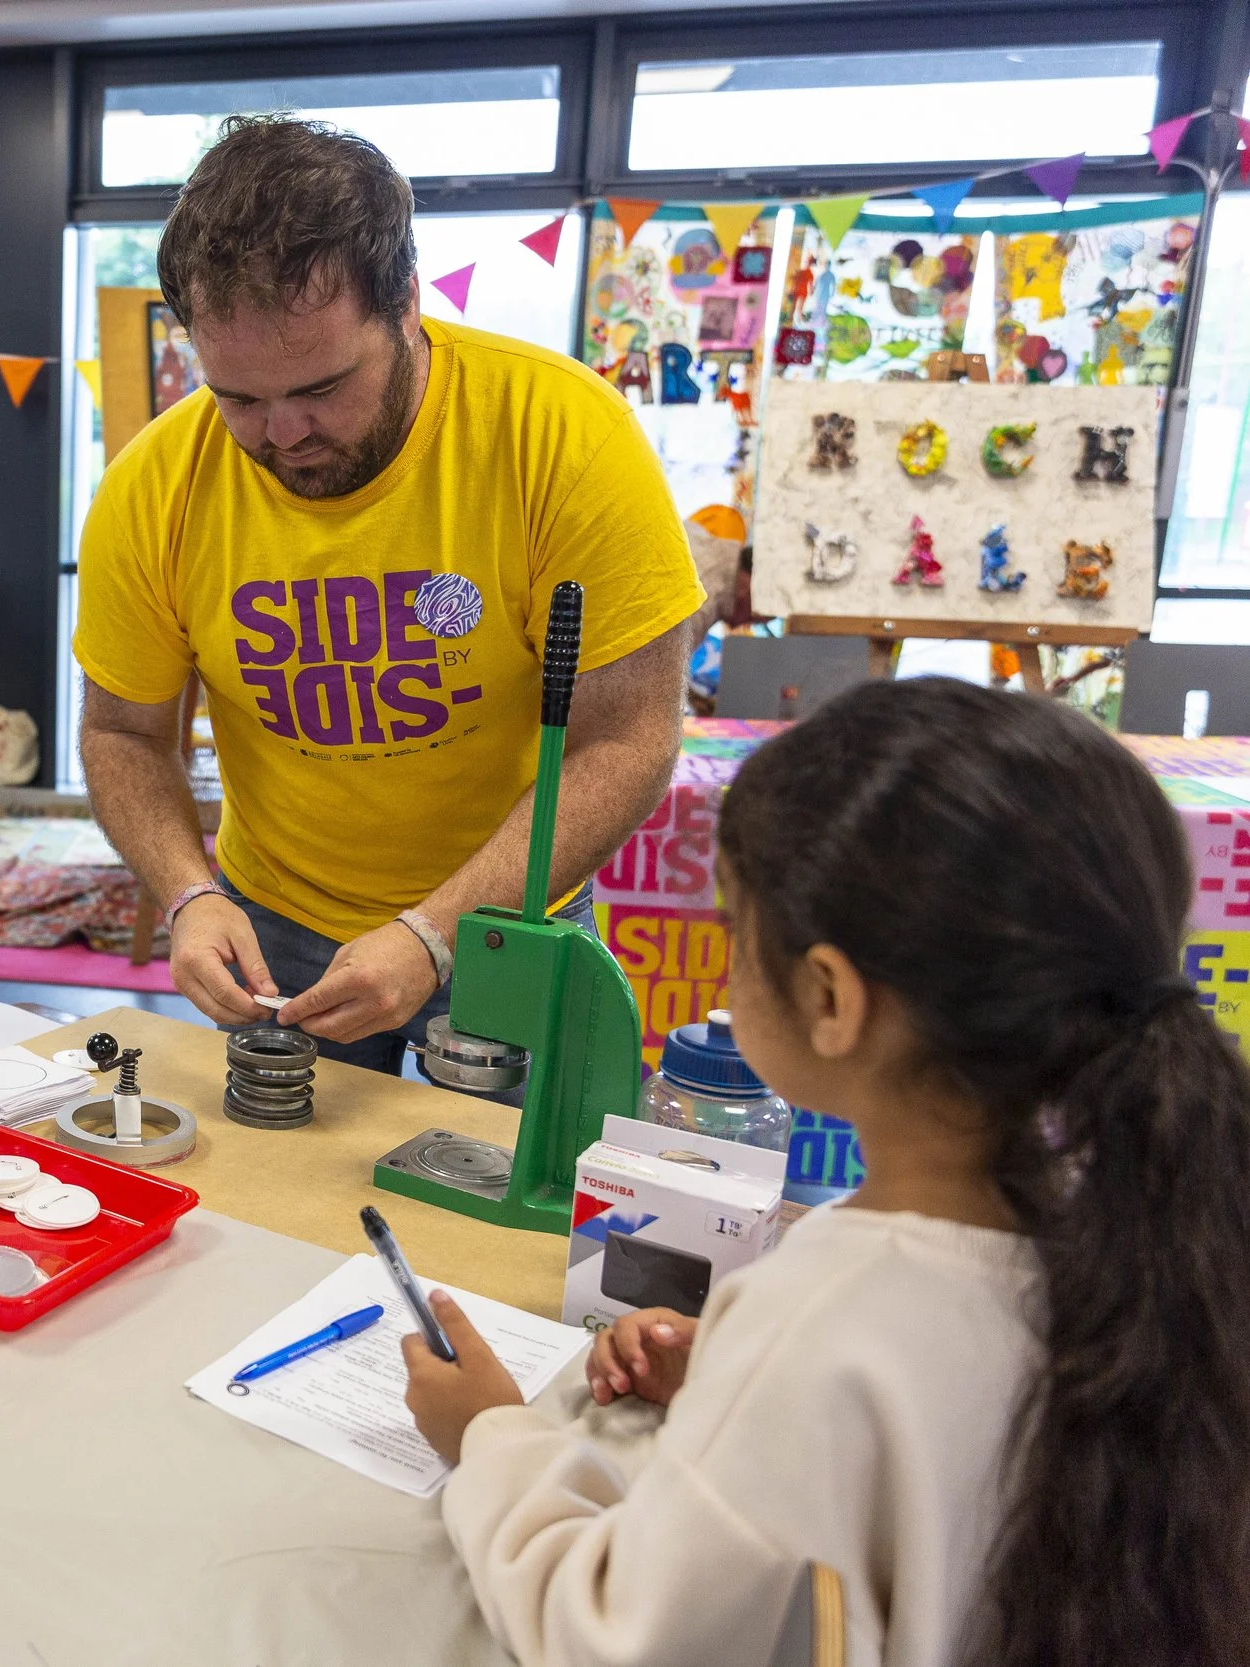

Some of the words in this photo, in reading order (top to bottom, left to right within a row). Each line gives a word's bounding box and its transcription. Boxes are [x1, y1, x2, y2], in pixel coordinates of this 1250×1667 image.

[443, 648, 473, 668] BY
[1217, 1000, 1242, 1014] BY
[581, 1176, 635, 1198] TOSHIBA
[714, 1216, 727, 1235] 1
